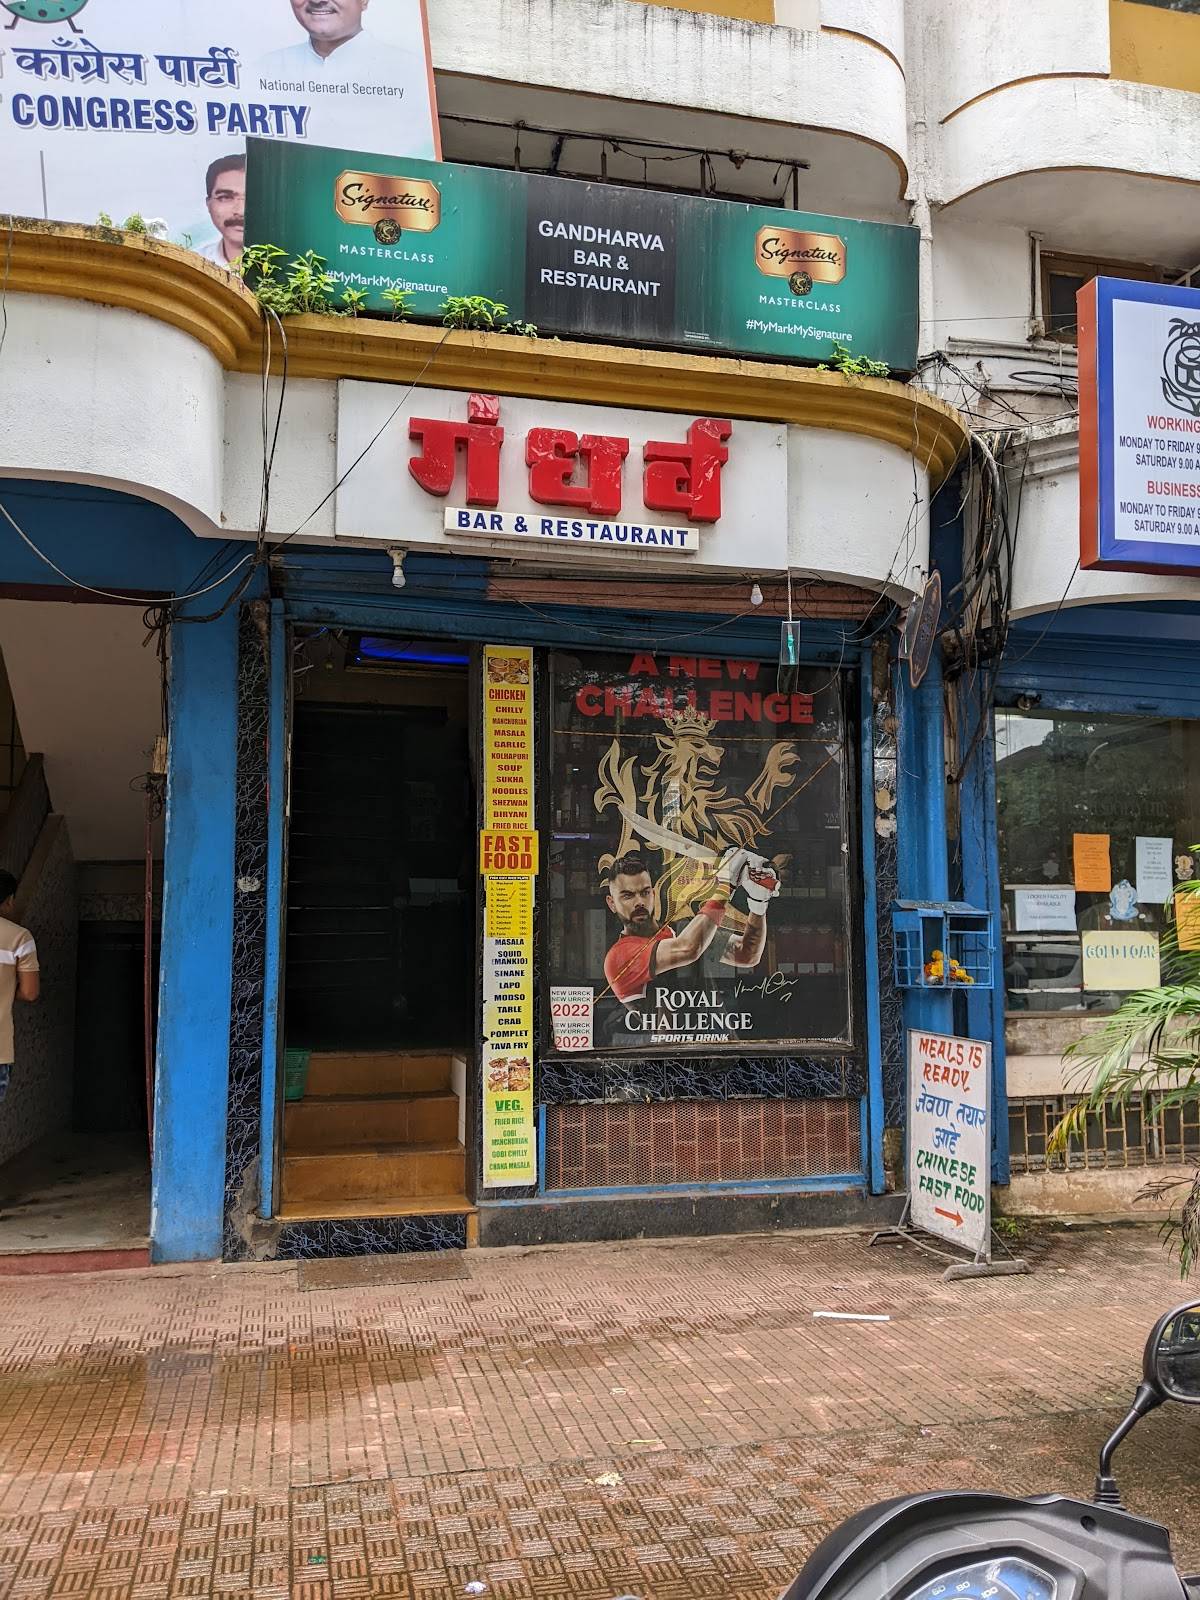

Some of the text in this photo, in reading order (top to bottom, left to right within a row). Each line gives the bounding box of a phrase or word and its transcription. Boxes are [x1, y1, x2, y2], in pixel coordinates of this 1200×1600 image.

[155, 47, 240, 86] पार्टी
[259, 78, 405, 98] National General Secretary
[12, 93, 309, 137] CONGRESS PARTY
[538, 220, 665, 252] GANDHARVA
[339, 244, 435, 264] MASTERCLASS
[573, 250, 630, 271] BAR &
[760, 238, 841, 266] Signature
[325, 270, 448, 294] #MyMarkMySignature
[540, 268, 661, 297] RESTAURANT
[759, 295, 841, 313] MASTERCLASS
[745, 319, 853, 341] #MyMarkMySignature
[1147, 415, 1200, 434] WORKING
[1119, 436, 1153, 450] MONDAY
[1155, 439, 1166, 451] TO
[1167, 440, 1195, 453] FRIDAY
[408, 393, 733, 523] गंधर्व
[1135, 454, 1177, 469] SATURDAY
[1178, 458, 1194, 470] 9.00
[1120, 501, 1153, 516] MONDAY
[1155, 504, 1166, 516] TO
[1168, 506, 1195, 518] FRIDAY
[457, 511, 689, 547] BAR & RESTAURANT
[1134, 519, 1176, 534] SATURDAY
[1177, 523, 1192, 535] 9.00
[629, 653, 761, 681] A NEW
[489, 688, 526, 700] CHICKEN
[575, 684, 815, 724] CHALLENGE
[484, 835, 533, 852] FAST
[484, 853, 532, 869] FOOD
[655, 987, 723, 1011] ROYAL
[552, 1004, 590, 1017] 2022
[624, 1011, 753, 1031] CHALLENGE
[490, 1030, 528, 1038] POMPLET
[556, 1036, 590, 1048] 2022
[650, 1033, 729, 1043] SPORTS DRINK
[490, 1041, 528, 1050] TAVA FRY
[918, 1037, 983, 1070] MEALS IS
[495, 1099, 524, 1111] VEG.
[915, 1084, 987, 1135] जेवण तयार
[933, 1123, 961, 1155] आहे
[916, 1149, 977, 1186] CHINESE
[919, 1175, 985, 1214] FAST FOOD
[981, 1586, 999, 1599] 100
